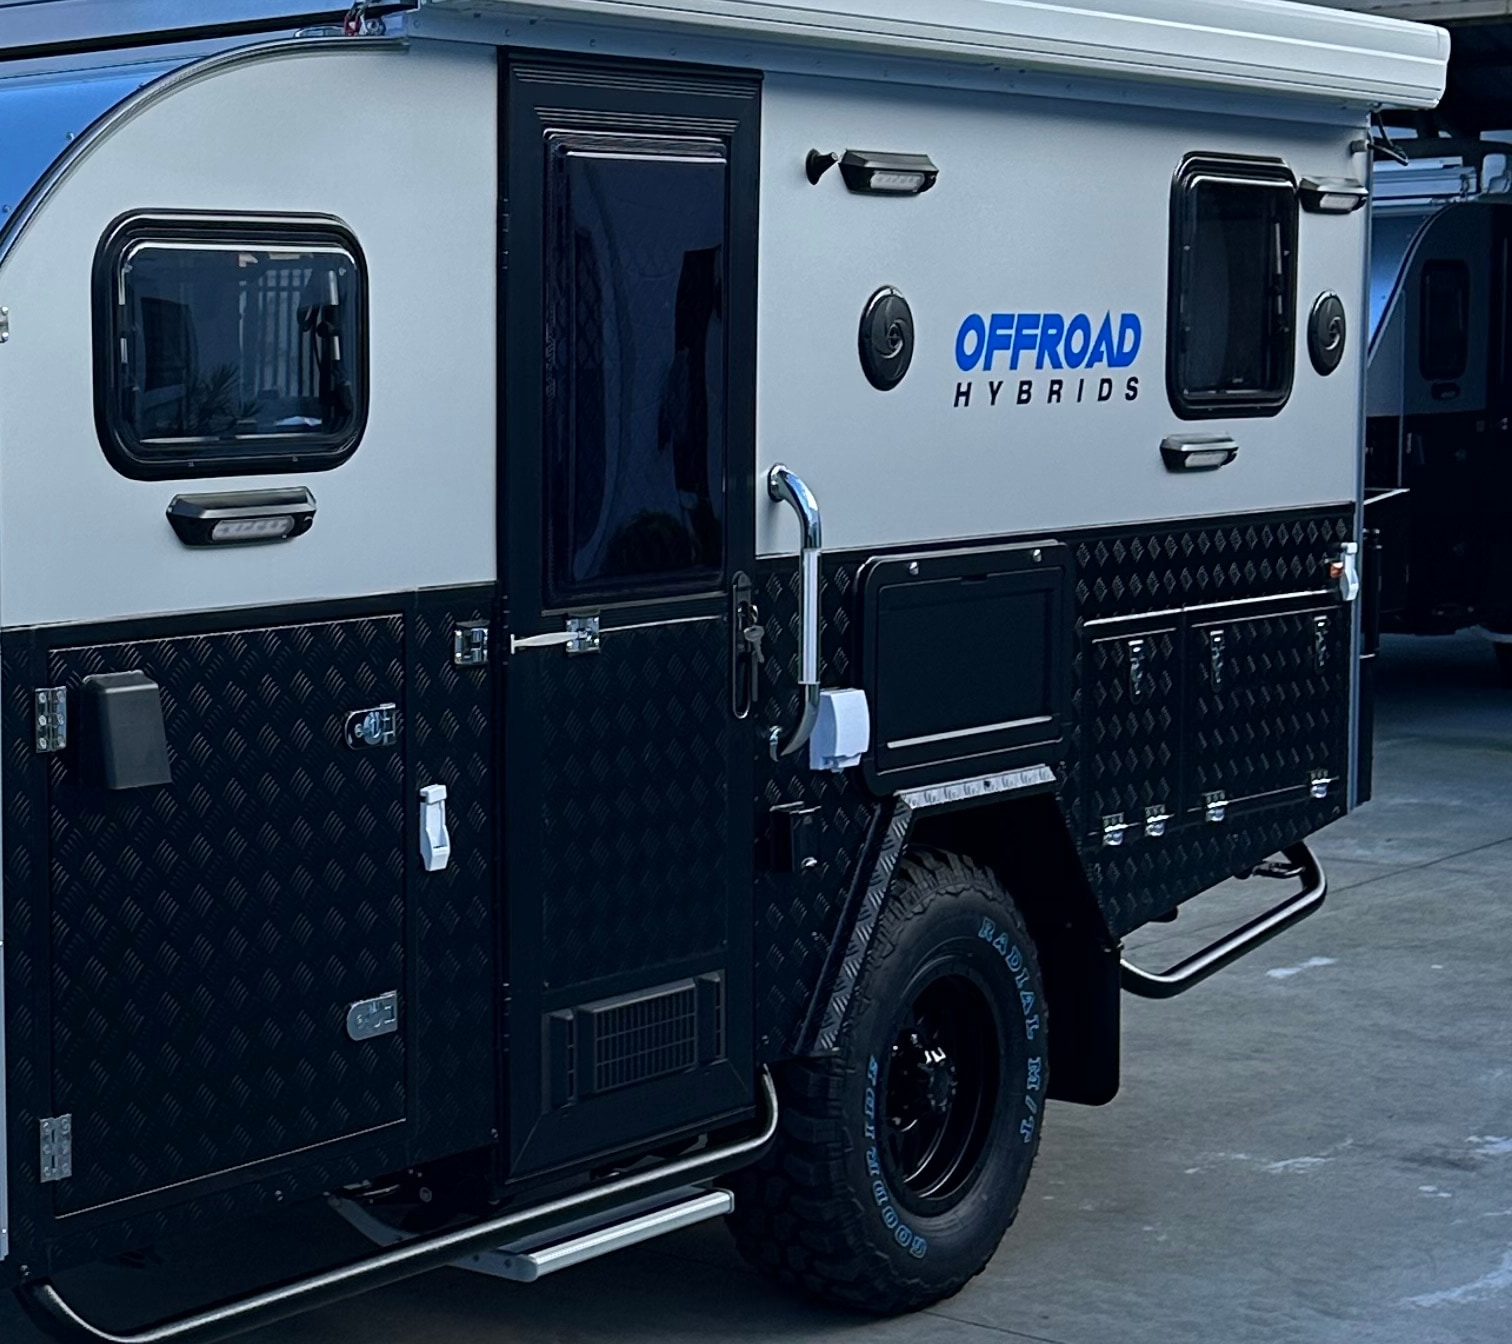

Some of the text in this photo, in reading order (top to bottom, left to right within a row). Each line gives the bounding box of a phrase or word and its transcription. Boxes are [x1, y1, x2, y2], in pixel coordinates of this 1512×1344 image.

[953, 376, 1140, 408] HYBRIDS
[955, 309, 1142, 372] OFFROAD
[978, 916, 1042, 1144] RADIAL M/T
[864, 1054, 928, 1260] GOODRIDE
